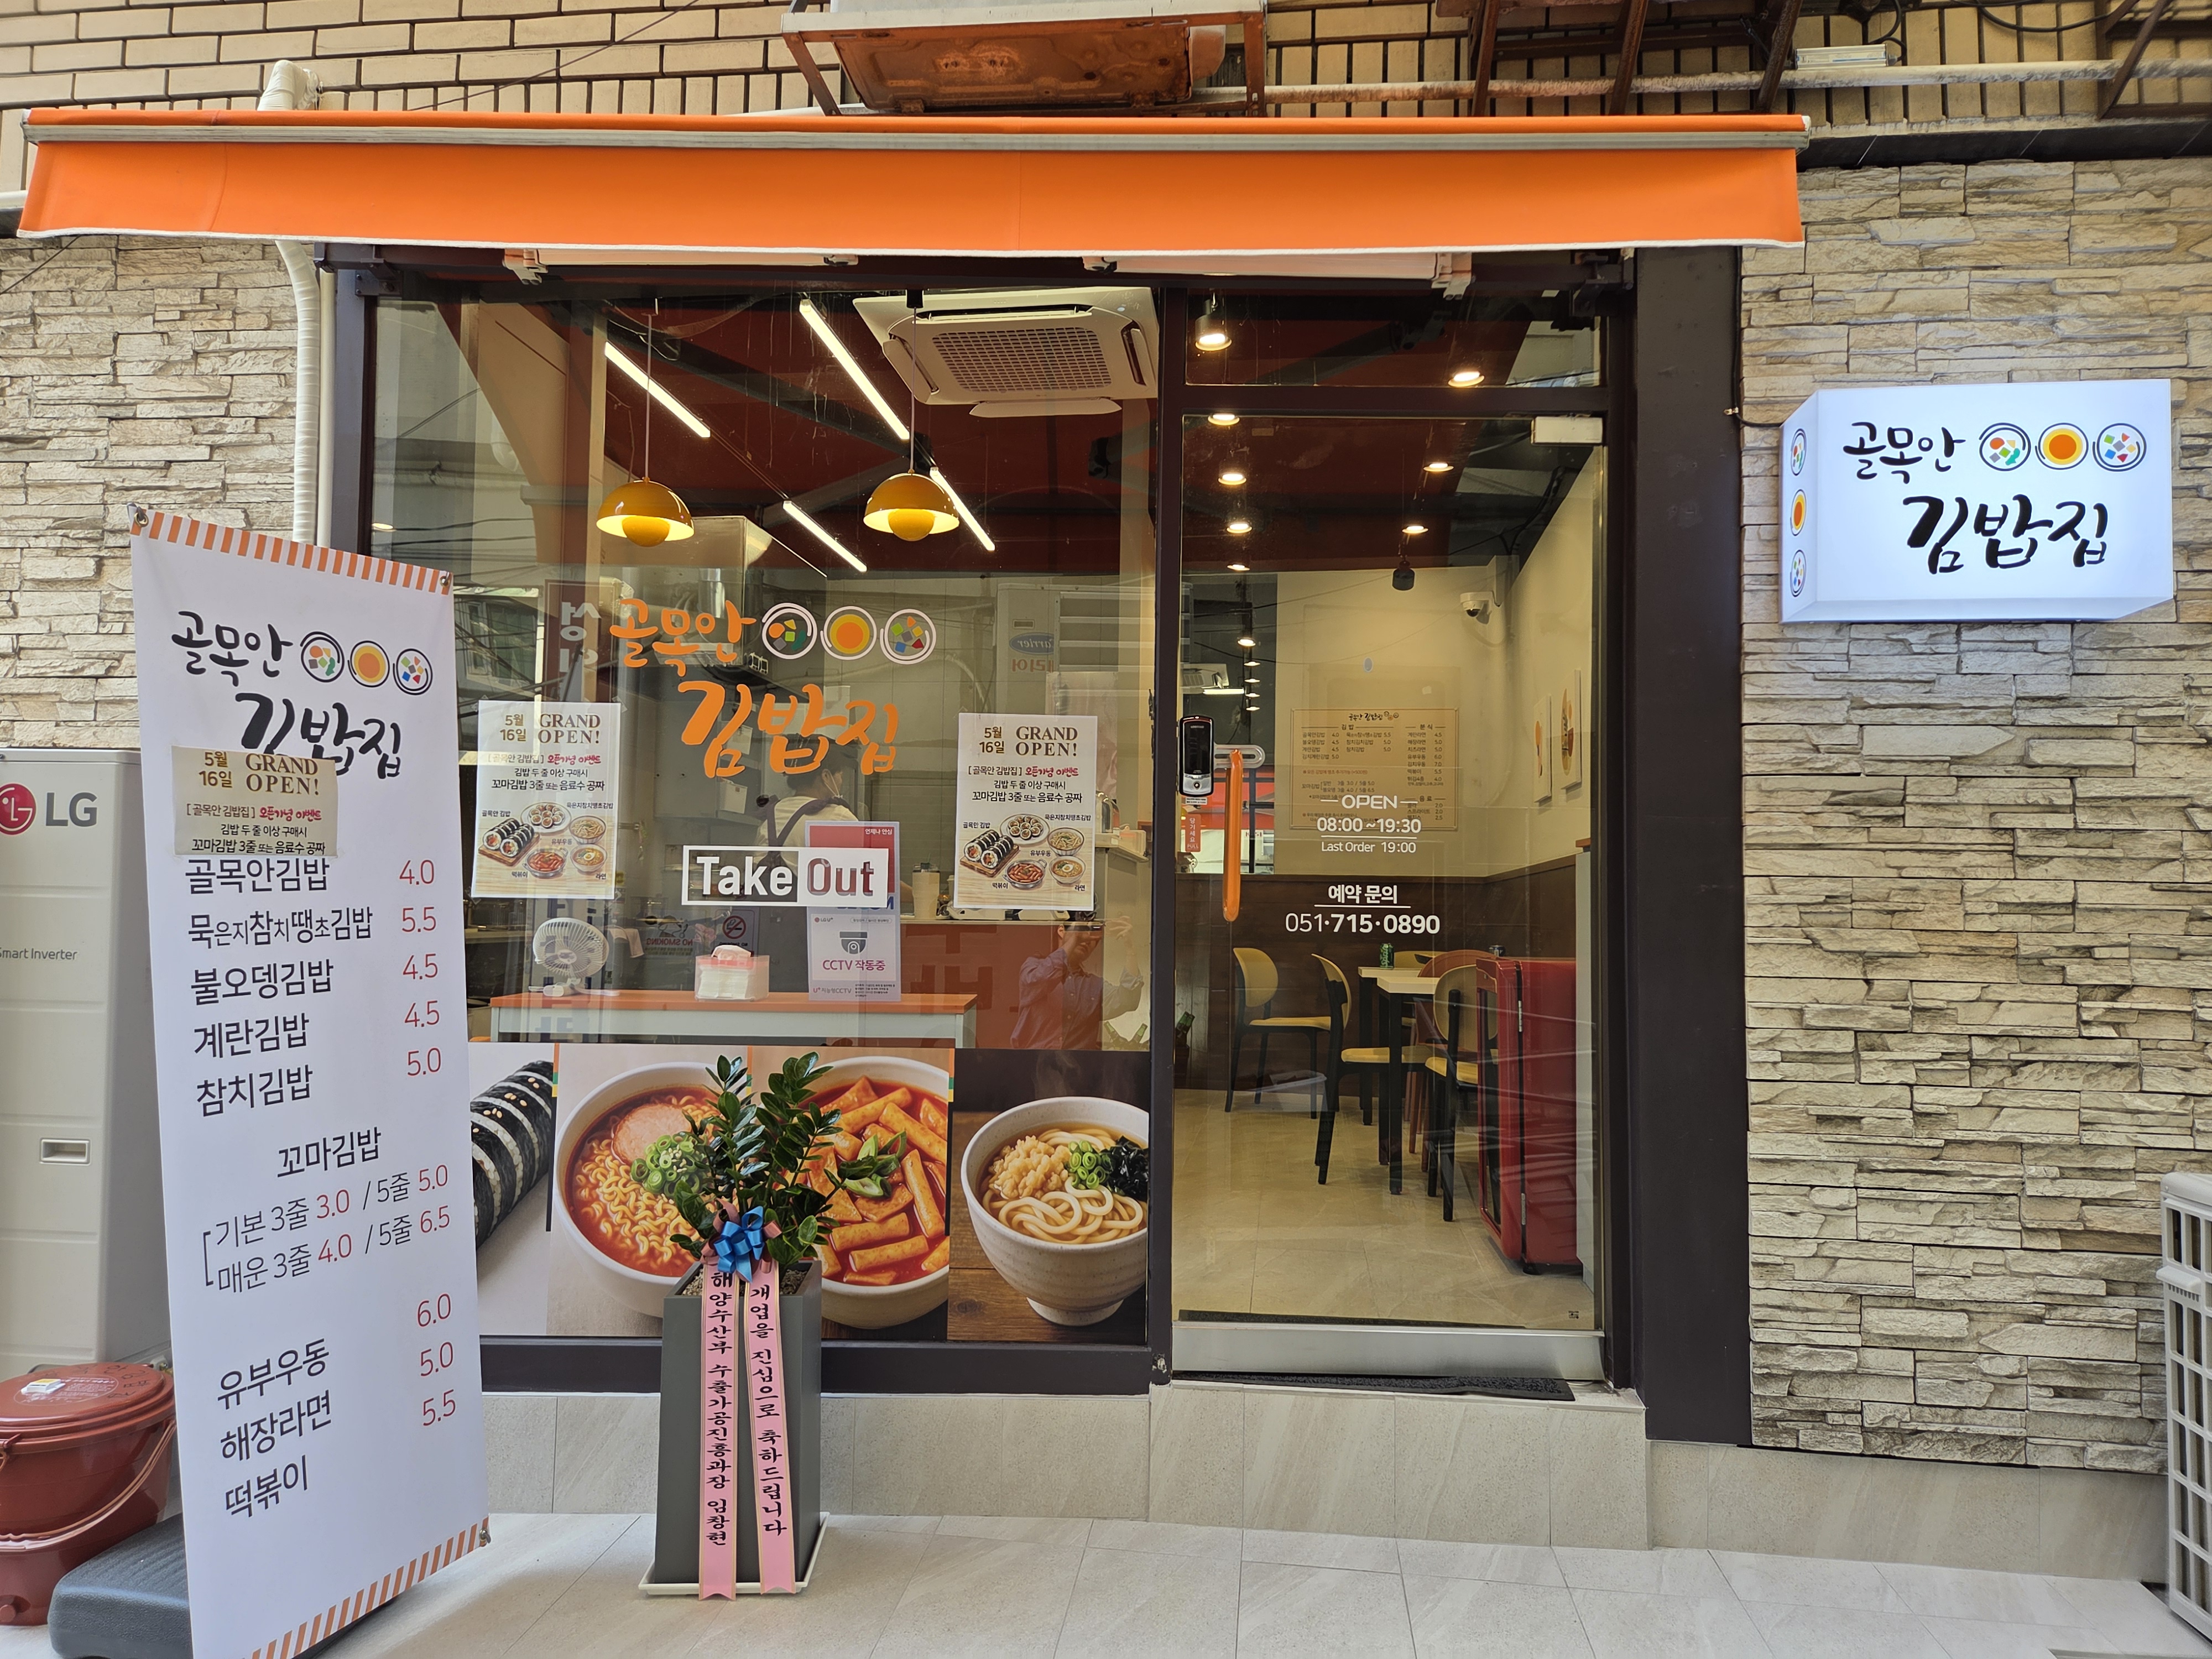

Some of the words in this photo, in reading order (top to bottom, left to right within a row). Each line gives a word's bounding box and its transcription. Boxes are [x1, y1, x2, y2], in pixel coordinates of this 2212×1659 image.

[1843, 421, 1966, 483] 골목안
[1902, 494, 2108, 575] 김밥집
[609, 598, 757, 676] 골목안
[171, 611, 293, 686] 골목안
[505, 714, 524, 726] 5월
[540, 713, 601, 728] GRAND
[677, 680, 899, 779] 김밥집
[500, 728, 526, 742] 16일
[538, 729, 599, 743] OPEN!
[984, 727, 1002, 739] 5월
[1016, 726, 1078, 740] GRAND
[979, 741, 1004, 754] 16일
[1015, 742, 1077, 757] OPEN!
[205, 751, 228, 768] 5월
[246, 753, 318, 775] GRAND
[547, 754, 576, 765] 오픈기념
[578, 755, 601, 764] 이벤트
[199, 770, 233, 788] 16일
[514, 768, 530, 777] 김밥
[541, 769, 548, 778] 줄
[550, 768, 565, 778] 이상
[566, 769, 588, 778] 구매시
[1025, 766, 1053, 777] 오픈기념
[1056, 767, 1079, 777] 이벤트
[246, 774, 319, 795] OPEN!
[492, 779, 528, 790] 꼬마김밥
[529, 780, 544, 790] 3줄
[545, 782, 559, 790] 또는
[560, 780, 585, 791] 음료수
[587, 780, 605, 791] 공짜
[994, 780, 1009, 789] 김밥
[1019, 781, 1026, 789] 줄
[1028, 781, 1042, 789] 이상
[1044, 781, 1066, 790] 구매시
[972, 791, 1006, 802] 꼬마김밥
[1008, 792, 1022, 802] 3줄
[1024, 794, 1036, 802] 또는
[1037, 792, 1063, 803] 음료수
[1065, 793, 1082, 803] 공짜
[1342, 795, 1397, 809] OPEN
[46, 792, 97, 827] LG
[259, 806, 293, 822] 오픈기념
[296, 808, 322, 822] 이벤트
[221, 824, 239, 835] 김밥
[241, 825, 251, 836] 두
[252, 825, 262, 836] 줄
[264, 825, 280, 837] 이상
[281, 826, 307, 838] 구매시
[192, 839, 237, 853] 꼬마김밥
[239, 840, 257, 853] 3줄
[258, 844, 273, 853] 또는
[275, 841, 305, 854] 음료수
[306, 842, 325, 855] 공짜
[1322, 842, 1343, 852] Last
[1345, 842, 1375, 852] Order
[1381, 842, 1416, 853] 19:00
[185, 858, 330, 894] 골목안김밥
[399, 860, 435, 885] 4.0
[696, 855, 792, 896] Take
[807, 858, 874, 896] Out
[1328, 884, 1361, 904] 예약
[1364, 885, 1397, 904] 문의
[188, 907, 373, 949] 묵은지참치땡초김밥
[401, 907, 437, 932] 5.5
[31, 948, 77, 961] Inverter
[822, 960, 853, 971] CCTV
[855, 959, 885, 971] 작동중
[191, 958, 334, 1006] 불오뎅김밥
[403, 953, 439, 979] 4.5
[194, 1013, 309, 1058] 계란김밥
[404, 1000, 440, 1028] 4.5
[196, 1065, 313, 1117] 참치김밥
[407, 1048, 441, 1076] 5.0
[277, 1126, 382, 1178] 꼬마김밥
[216, 1211, 267, 1249] 기본
[271, 1197, 310, 1232] 3줄
[316, 1189, 350, 1219] 3.0
[418, 1164, 449, 1193] 5.0
[218, 1255, 269, 1293] 매운
[273, 1243, 311, 1279] 3줄
[318, 1234, 353, 1264] 4.0
[419, 1205, 451, 1234] 6.5
[707, 1271, 733, 1354] 해양수산부
[749, 1285, 774, 1339] 개업을
[217, 1338, 329, 1410] 유부우동
[416, 1293, 452, 1327] 6.0
[751, 1349, 780, 1418] 진심으로
[221, 1389, 332, 1462] 해장라면
[420, 1342, 453, 1377] 5.0
[706, 1364, 732, 1489] 수출가공진흥과장
[225, 1454, 309, 1517] 떡볶이
[422, 1389, 456, 1426] 5.5
[758, 1429, 787, 1537] 축하드립니다
[706, 1498, 731, 1546] 임창현
